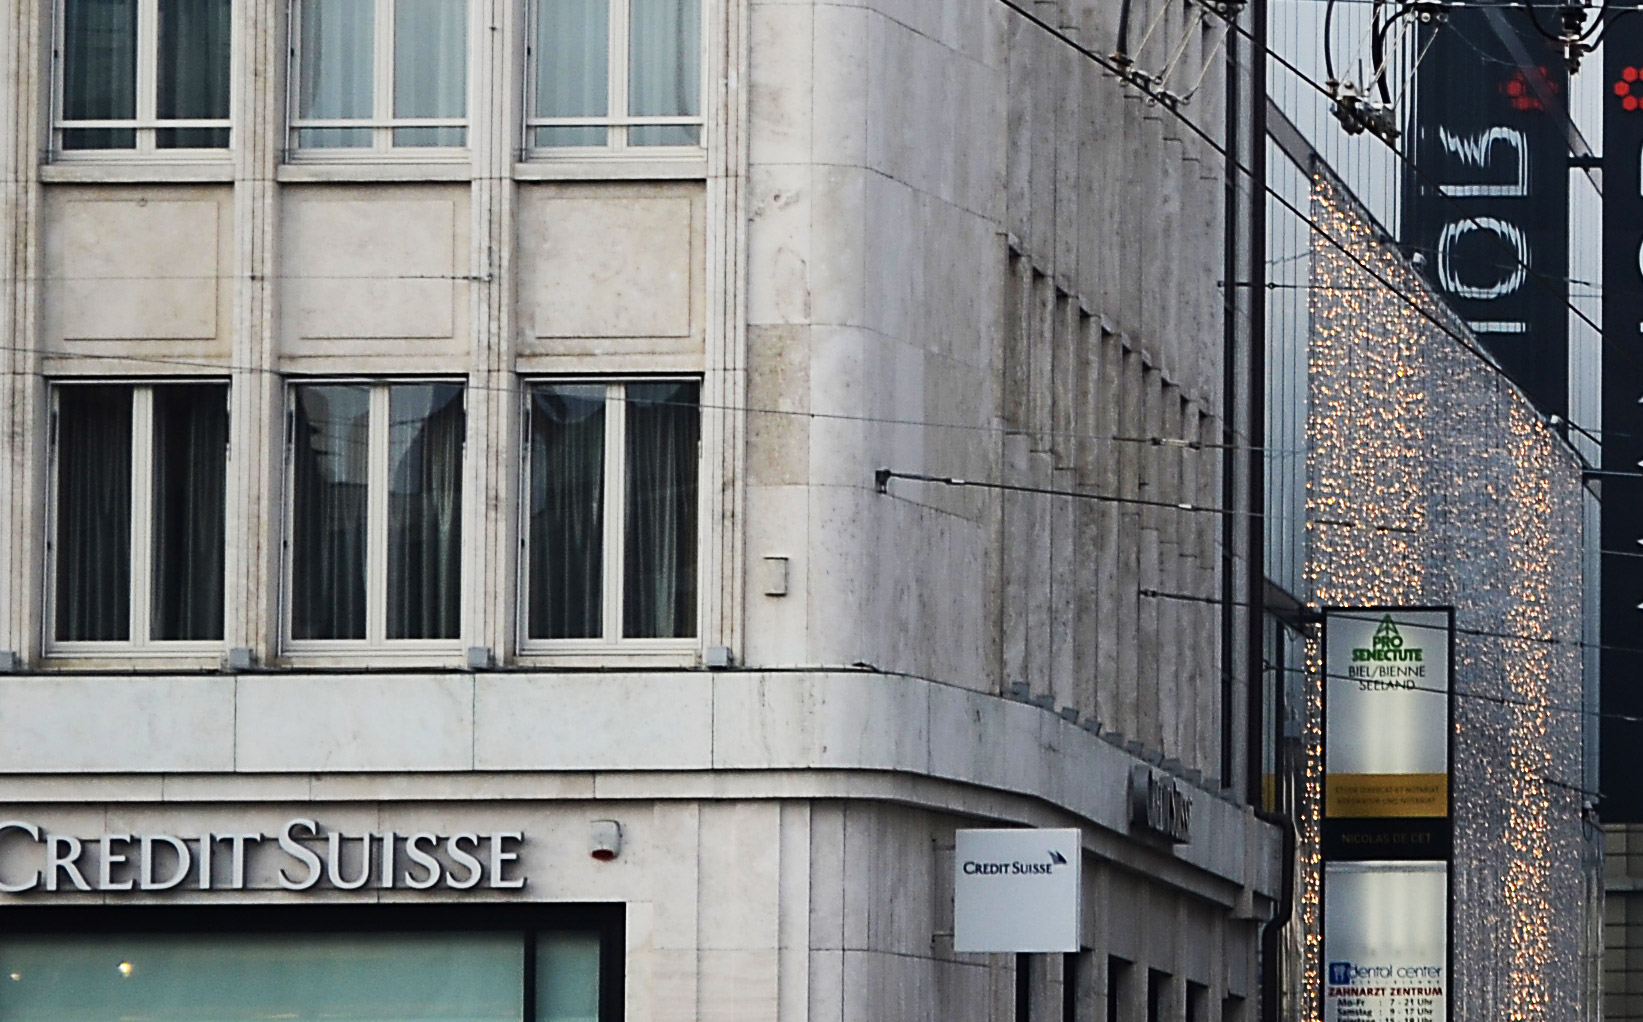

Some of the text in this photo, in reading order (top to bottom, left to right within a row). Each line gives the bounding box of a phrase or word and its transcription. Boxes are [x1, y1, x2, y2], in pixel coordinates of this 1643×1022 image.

[1373, 636, 1403, 648] PRO
[1352, 649, 1423, 661] SENECTUTE
[1348, 666, 1426, 677] BIEL/BIENNE
[1360, 680, 1415, 691] SEELAND
[0, 818, 528, 892] CREDIT SUISSE
[963, 861, 1053, 874] CREDIT SUISSE
[1348, 964, 1443, 979] dental center
[1328, 987, 1443, 997] ZAHNARZT ZENTRUM
